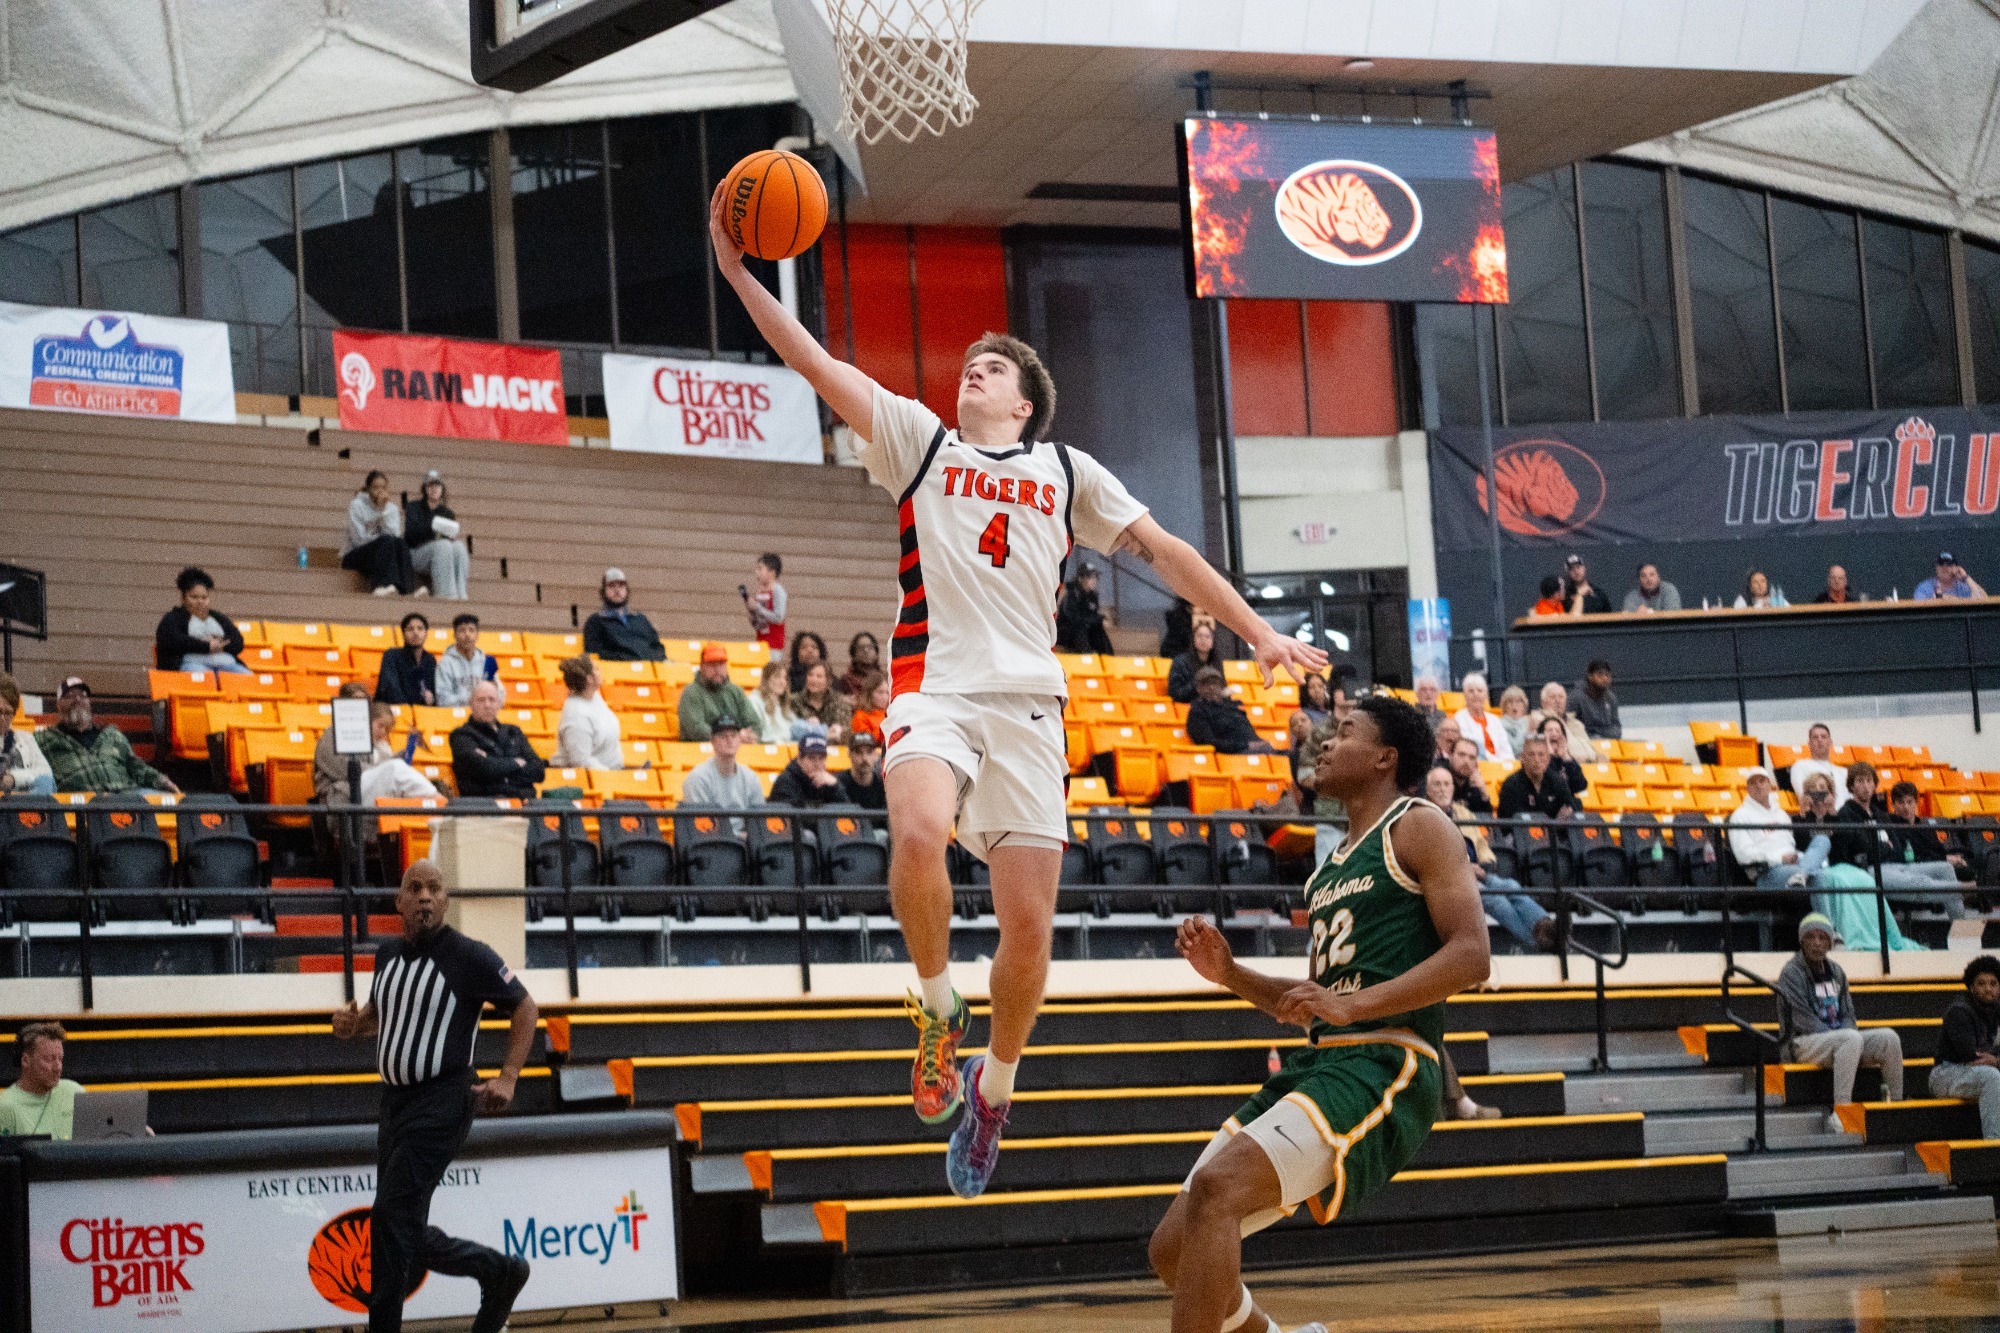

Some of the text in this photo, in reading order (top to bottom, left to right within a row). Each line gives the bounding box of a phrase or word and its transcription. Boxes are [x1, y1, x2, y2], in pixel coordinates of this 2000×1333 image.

[731, 177, 757, 247] Wilson
[42, 341, 174, 374] Communication
[44, 365, 92, 379] FEDERAL
[96, 368, 136, 383] CREDIT
[139, 372, 174, 387] UNION
[54, 390, 159, 413] ECU ATHLETICS
[653, 366, 771, 412] Citizens
[682, 408, 766, 445] Bank
[942, 466, 1056, 515] TIGERS
[978, 512, 1010, 568] 4
[1312, 907, 1356, 980] 22
[246, 1177, 291, 1199] EAST
[296, 1173, 377, 1196] CENTRAL
[59, 1216, 205, 1264] Citizens
[503, 1217, 617, 1265] Mercy
[91, 1258, 194, 1308] Bank
